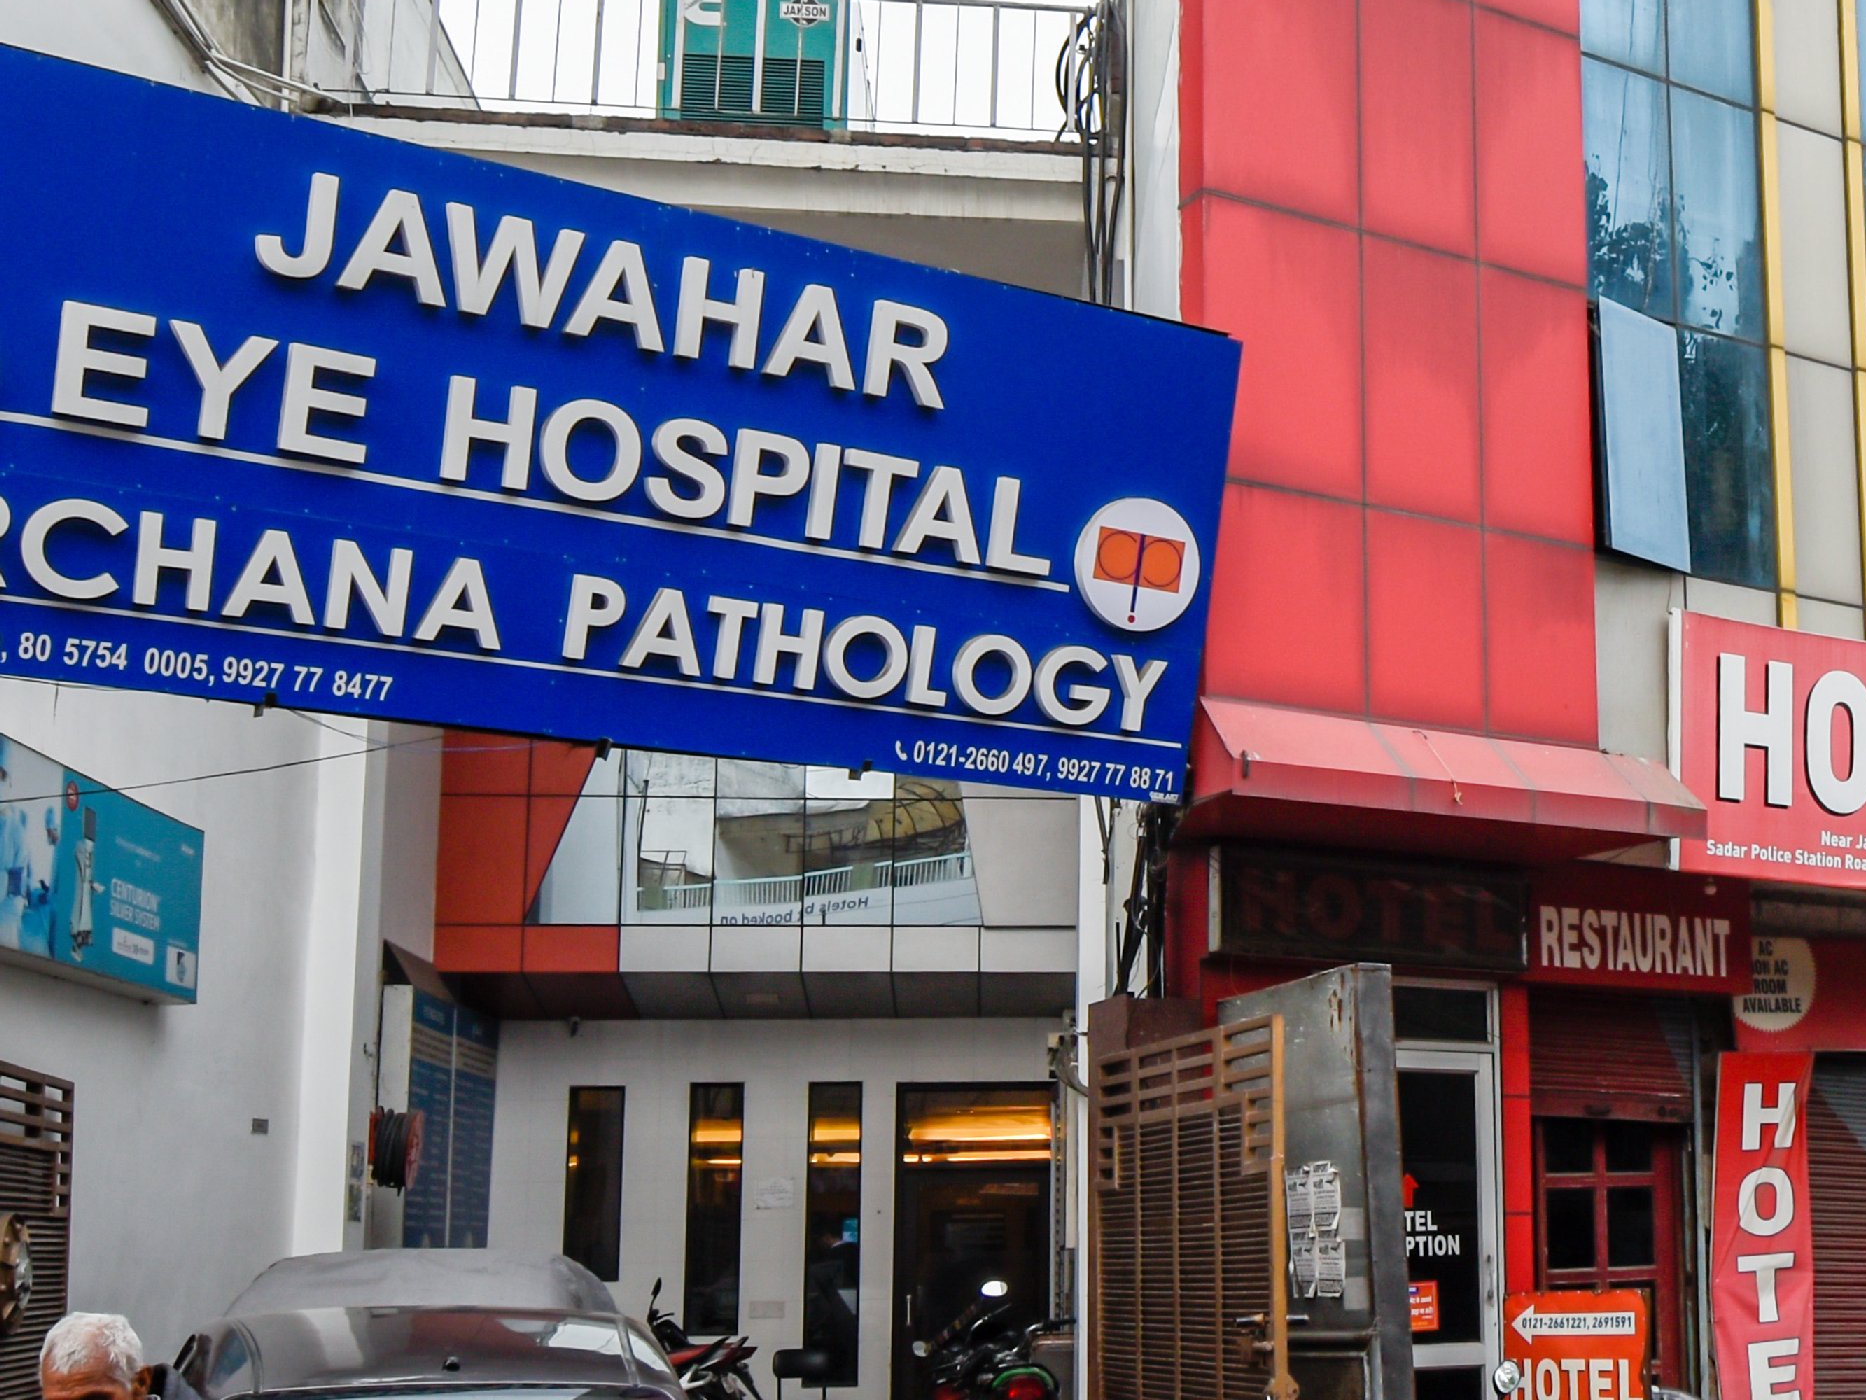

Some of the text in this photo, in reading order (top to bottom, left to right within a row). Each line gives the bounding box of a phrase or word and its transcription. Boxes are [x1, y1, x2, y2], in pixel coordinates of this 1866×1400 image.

[783, 3, 827, 19] JAKSON
[255, 172, 949, 409] JAWAHAR
[51, 300, 1051, 577] EYE HOSPITAL
[0, 496, 1168, 732] CHANA PATHOLOGY
[18, 632, 393, 701] 80 5754 0005, 9927 77 8477
[913, 739, 1174, 792] 0121-2660 497, 9927 77 88 71
[1706, 839, 1747, 858] Sadar
[1751, 844, 1791, 863] Police
[1794, 849, 1841, 869] Station
[1820, 830, 1853, 848] Near
[1238, 866, 1516, 953] HOTEL
[1539, 905, 1730, 977] RESTAURANT
[1758, 941, 1773, 956] AC
[1752, 958, 1788, 975] ON AC
[1742, 997, 1802, 1014] AVAILABLE
[1404, 1210, 1438, 1232] TEL
[1406, 1234, 1460, 1257] PTION
[1522, 1315, 1632, 1330] 0121-2661221, 2691591
[1511, 1357, 1644, 1400] HOTEL
